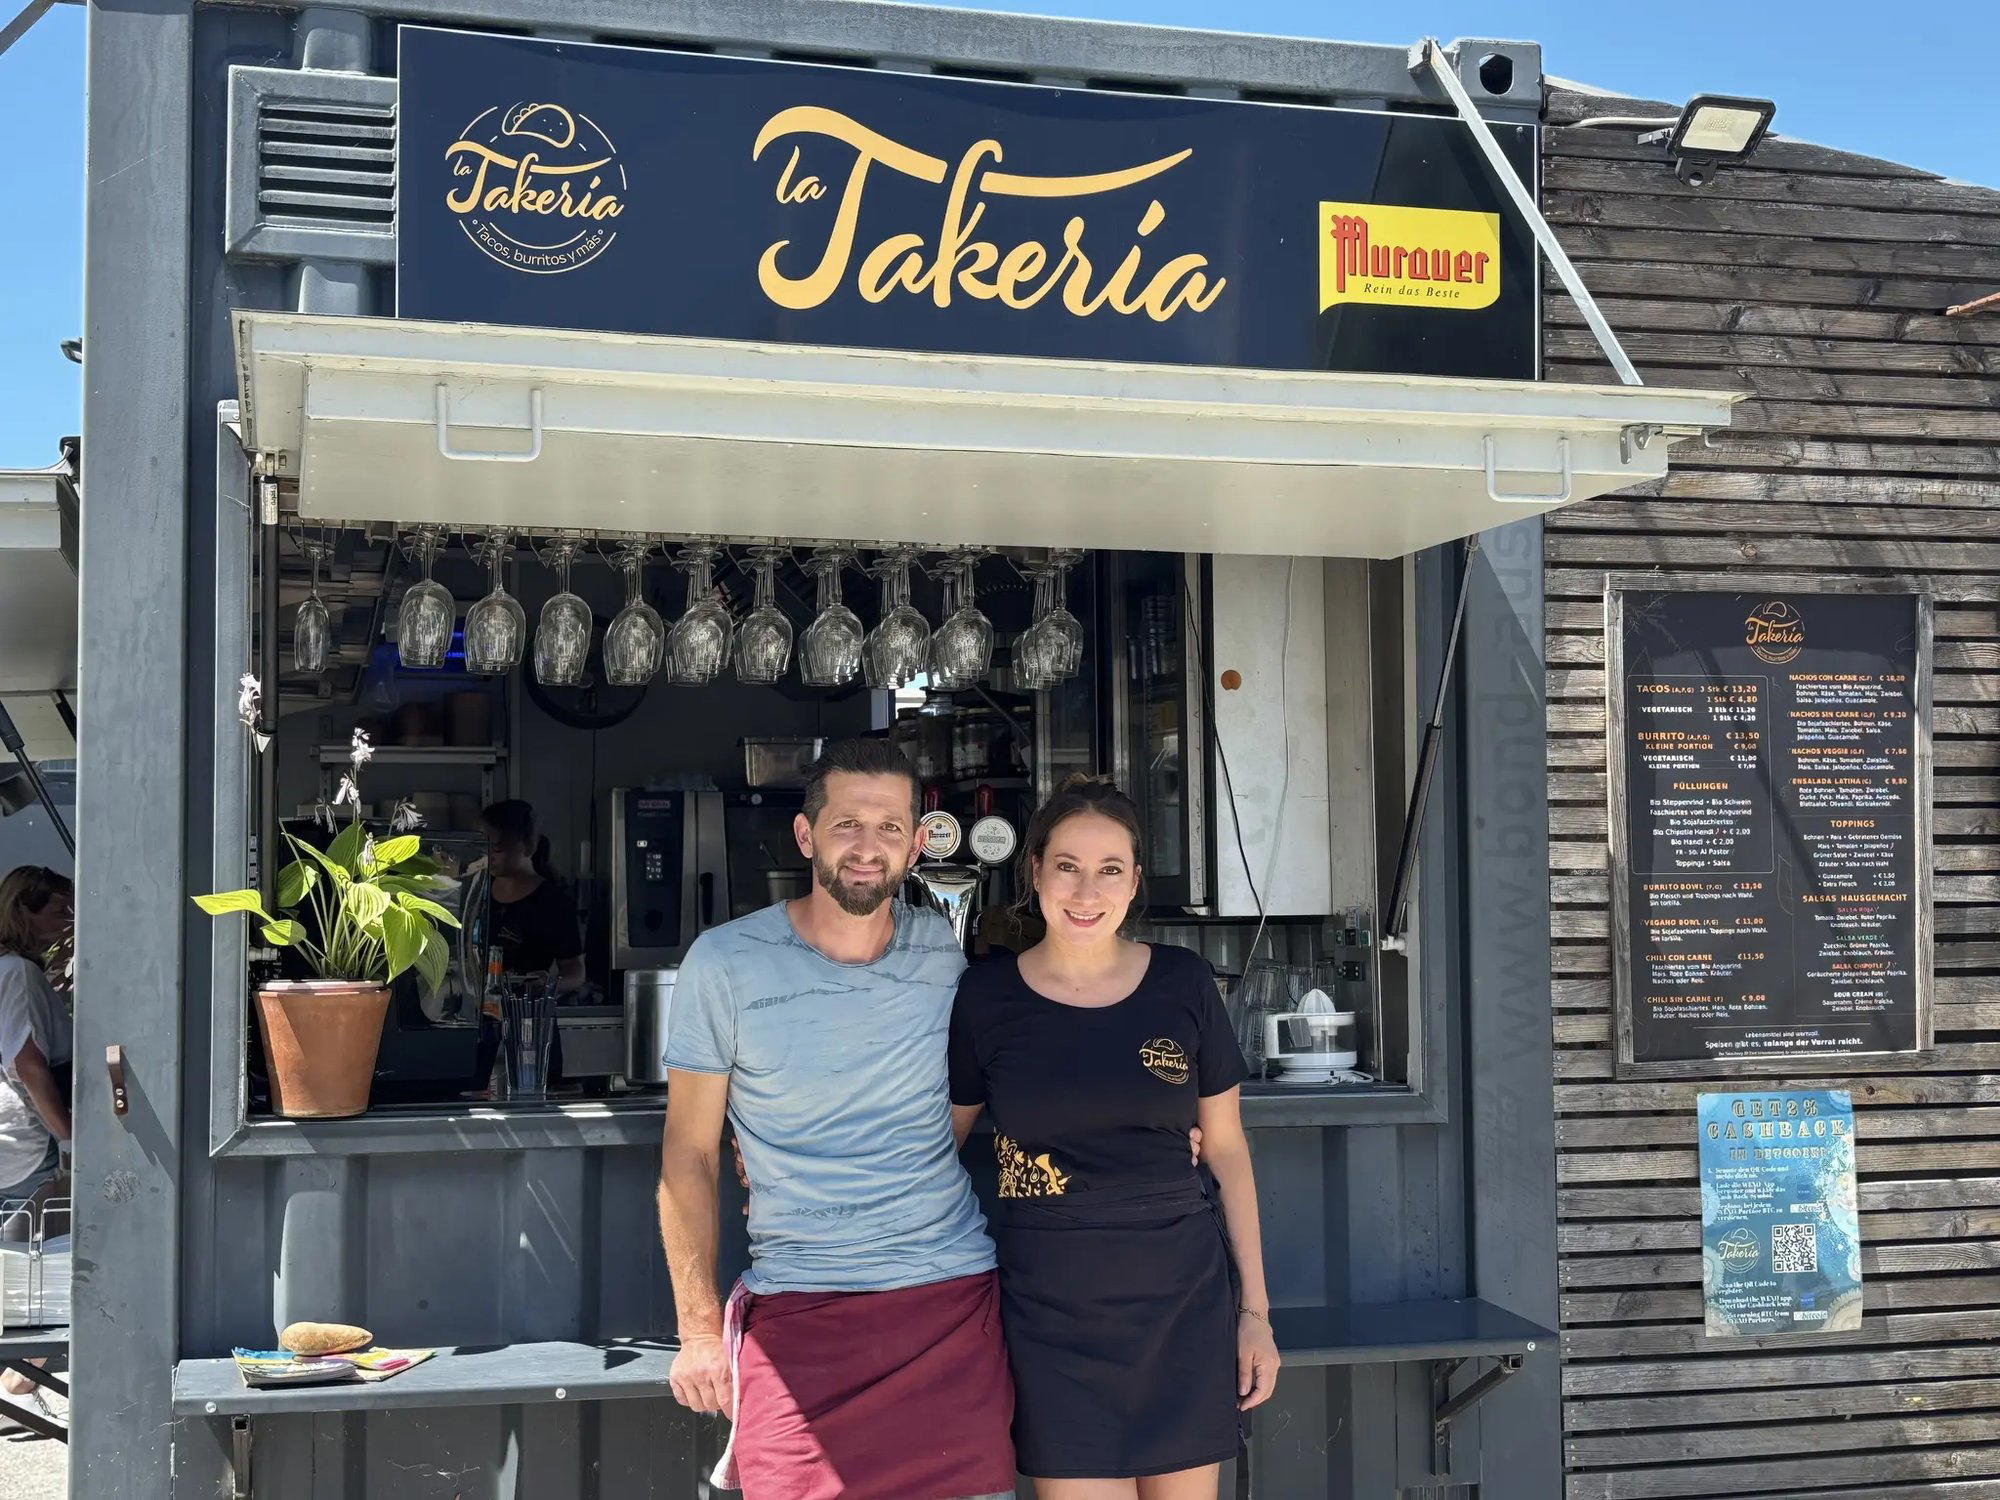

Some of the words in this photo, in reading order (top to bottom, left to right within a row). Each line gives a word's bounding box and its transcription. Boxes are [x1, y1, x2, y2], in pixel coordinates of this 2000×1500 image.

[452, 154, 473, 177] la
[775, 144, 828, 205] la
[475, 222, 512, 260] Tacos,
[513, 250, 568, 267] burritos
[567, 250, 577, 264] y
[575, 236, 602, 259] más
[1330, 213, 1490, 294] Murauer
[1363, 282, 1393, 295] Rein
[1397, 283, 1421, 297] das
[1425, 286, 1462, 300] Beste
[1636, 684, 1671, 694] TACOS
[1722, 685, 1729, 693] €
[1731, 685, 1758, 694] 13,20
[1641, 706, 1693, 714] VEGETARISCH
[1637, 732, 1685, 741] BURRITO
[1725, 732, 1732, 740] €
[1673, 781, 1729, 790] FÜLLUNGEN
[1706, 808, 1718, 816] Bio
[1669, 818, 1681, 826] Bio
[1829, 820, 1876, 829] TOPPINGS
[1670, 838, 1683, 846] Bio
[1675, 859, 1706, 868] Toppings
[1643, 883, 1679, 891] BURRITO
[1802, 894, 1837, 903] SALSAS
[1840, 893, 1908, 902] HAUSGEMACHT
[1644, 919, 1677, 927] VEGANO
[1645, 954, 1667, 962] CHILI
[1686, 953, 1713, 961] CARNE
[1646, 996, 1669, 1004] CHILI
[1685, 995, 1713, 1003] CARNE
[1705, 1040, 1734, 1050] Speisen
[1734, 1040, 1750, 1049] gibt
[1763, 1039, 1794, 1049] solange
[1795, 1038, 1810, 1047] der
[1811, 1038, 1837, 1046] Vorrat
[1706, 1119, 1845, 1140] CASHBACK
[1761, 1166, 1777, 1174] Code
